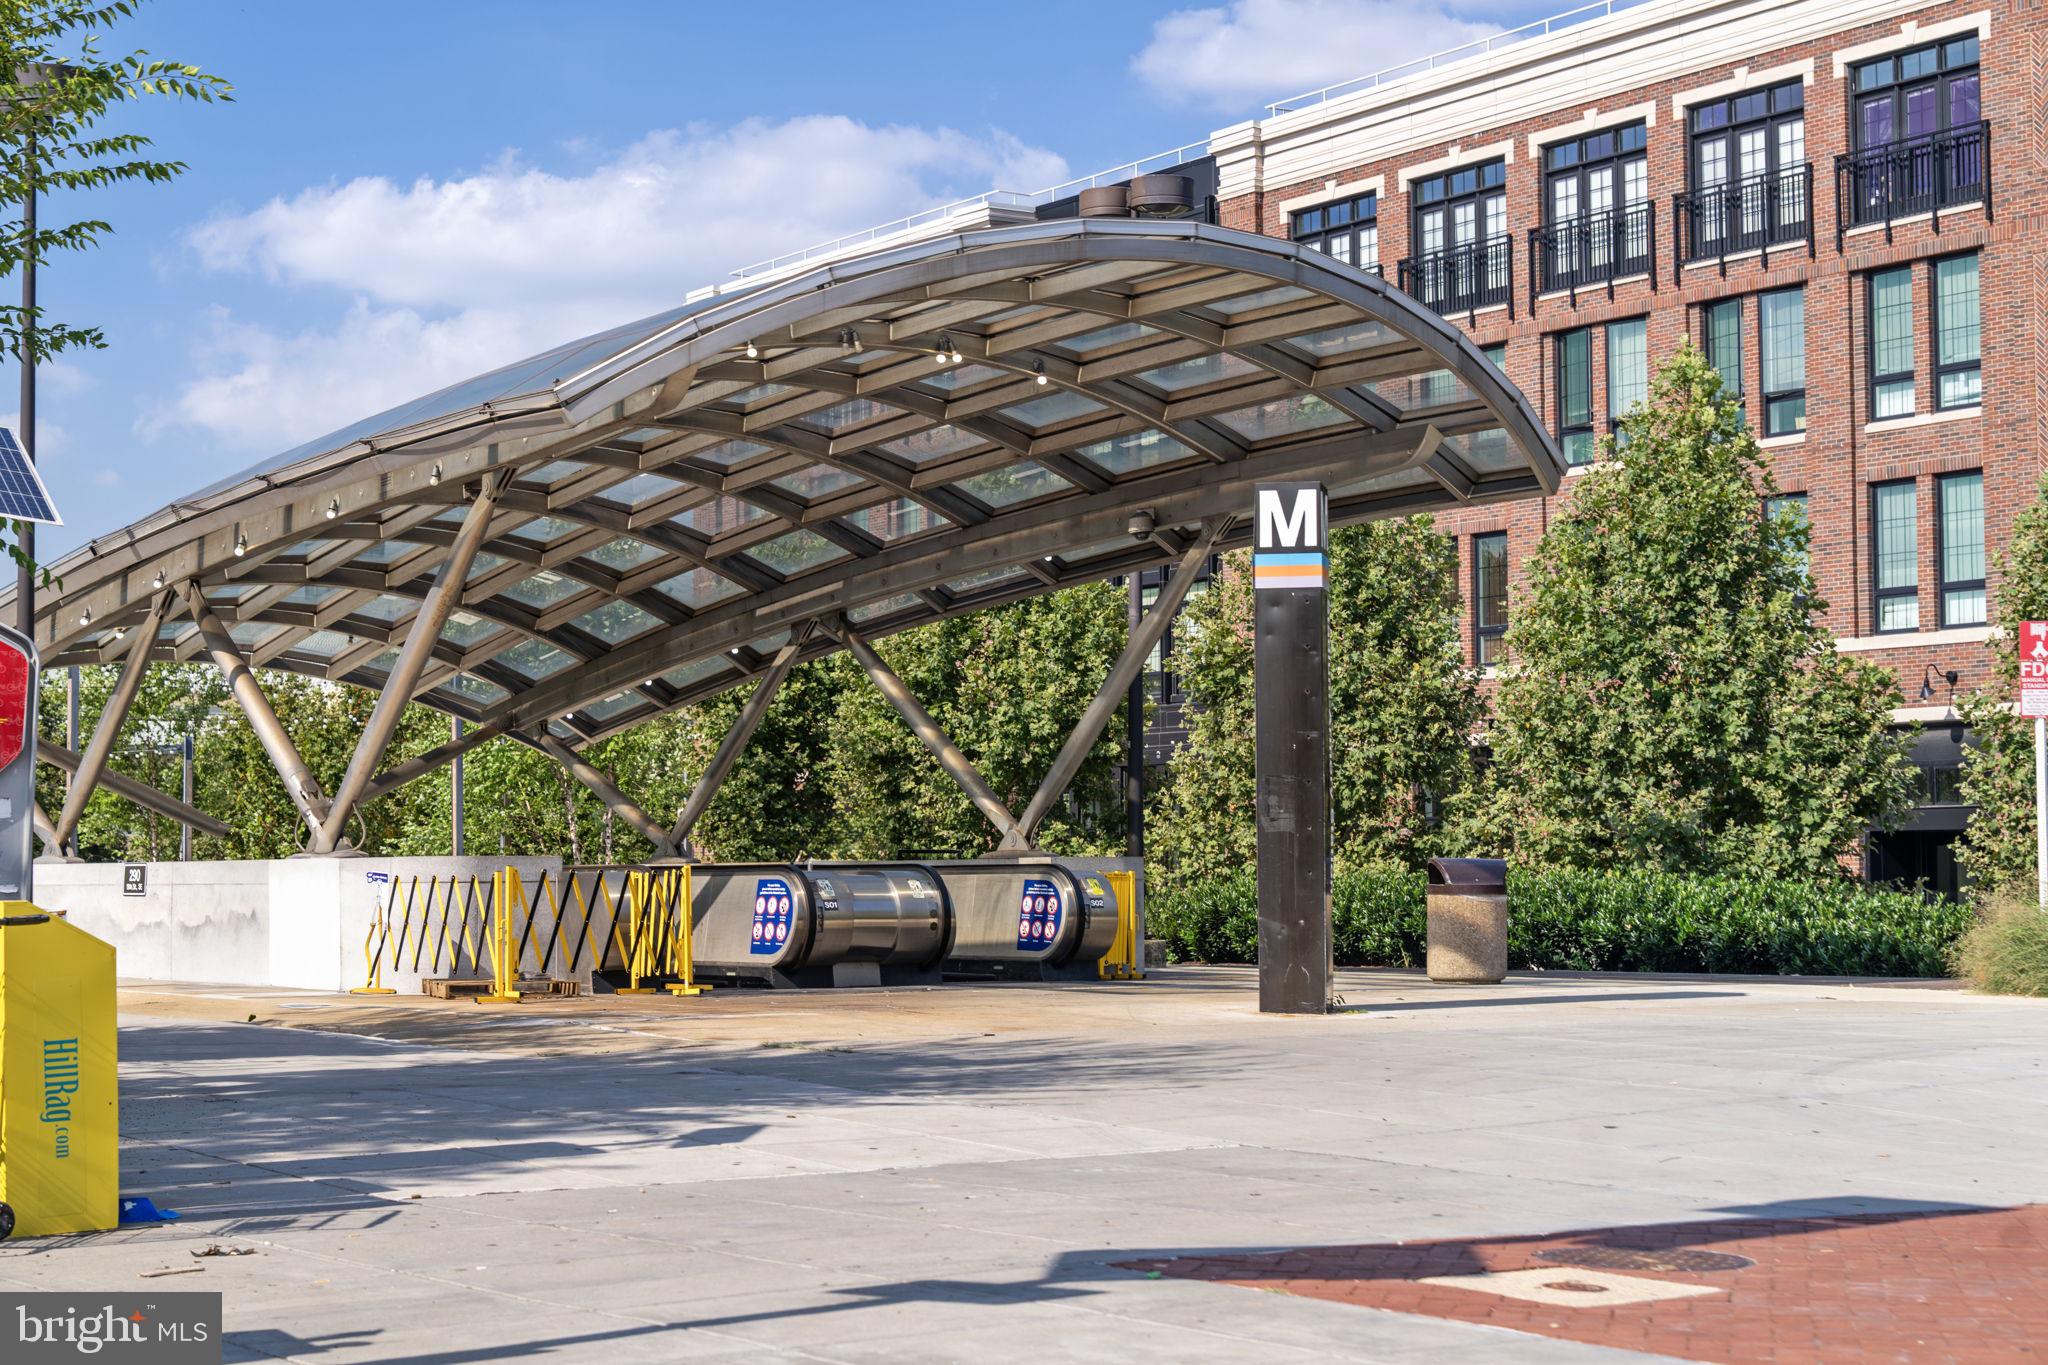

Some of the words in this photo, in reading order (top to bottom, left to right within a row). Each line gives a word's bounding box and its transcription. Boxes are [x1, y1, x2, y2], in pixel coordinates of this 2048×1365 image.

[1259, 489, 1317, 547] M
[2021, 661, 2048, 677] FD
[128, 869, 141, 882] 290
